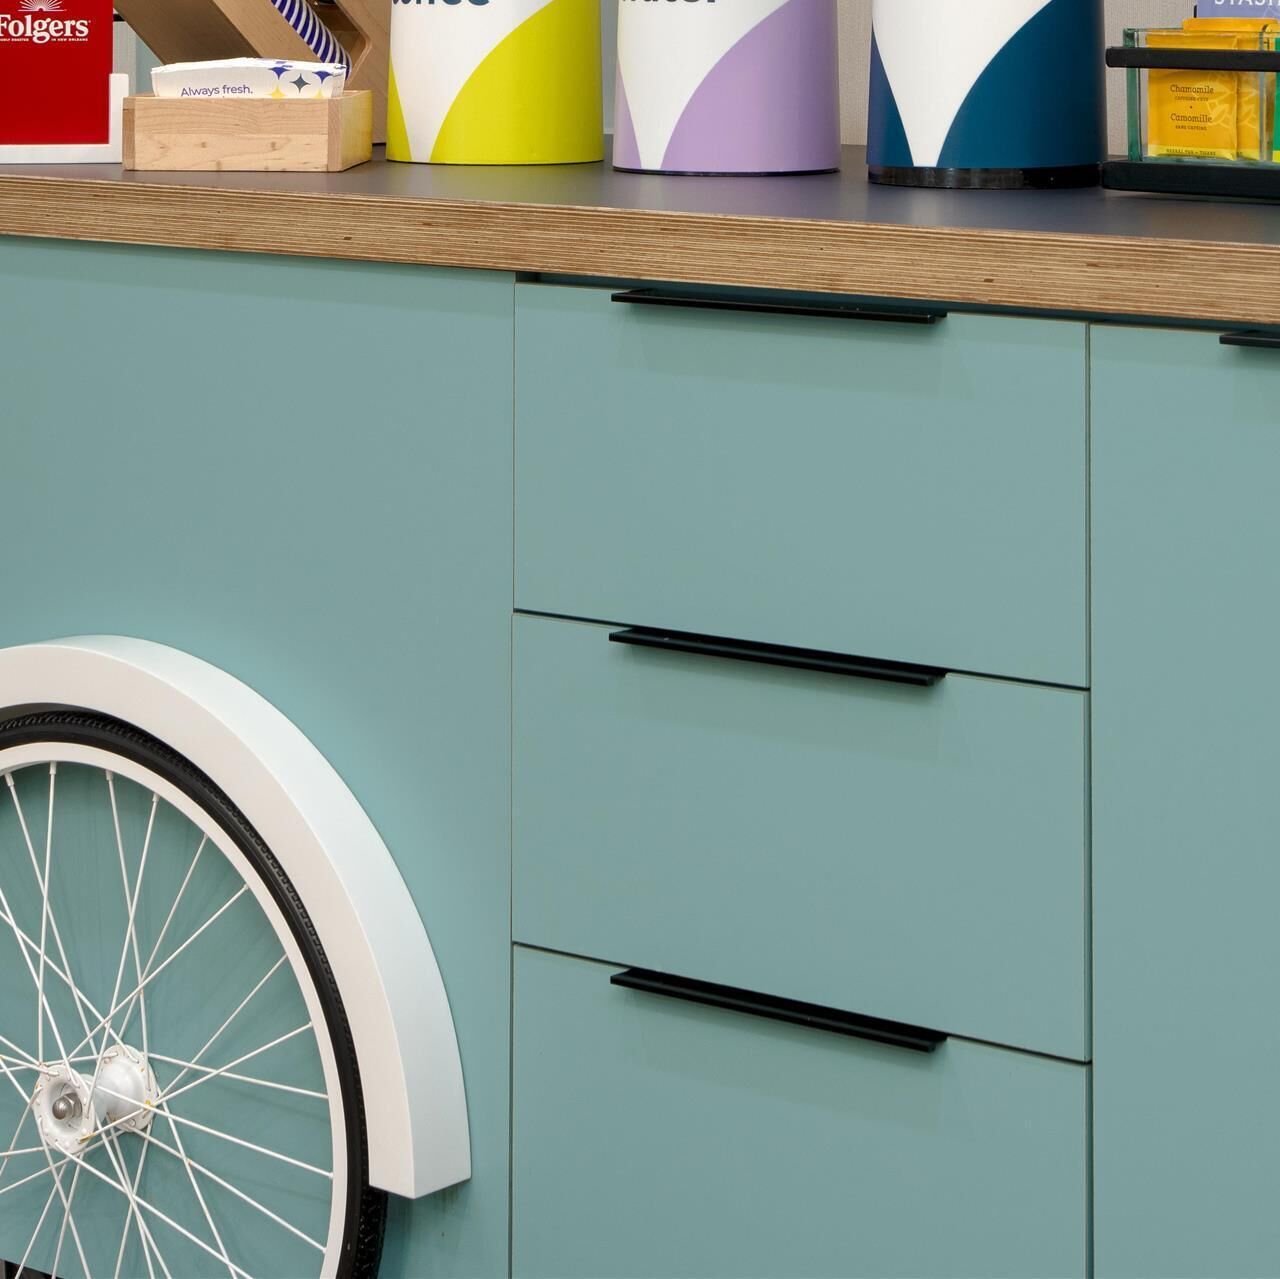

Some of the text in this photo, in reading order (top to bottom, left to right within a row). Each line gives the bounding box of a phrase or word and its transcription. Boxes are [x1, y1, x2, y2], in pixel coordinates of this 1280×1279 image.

[180, 84, 254, 97] Always fresh.
[1170, 84, 1215, 94] Chamomile
[1170, 113, 1213, 124] Camomille
